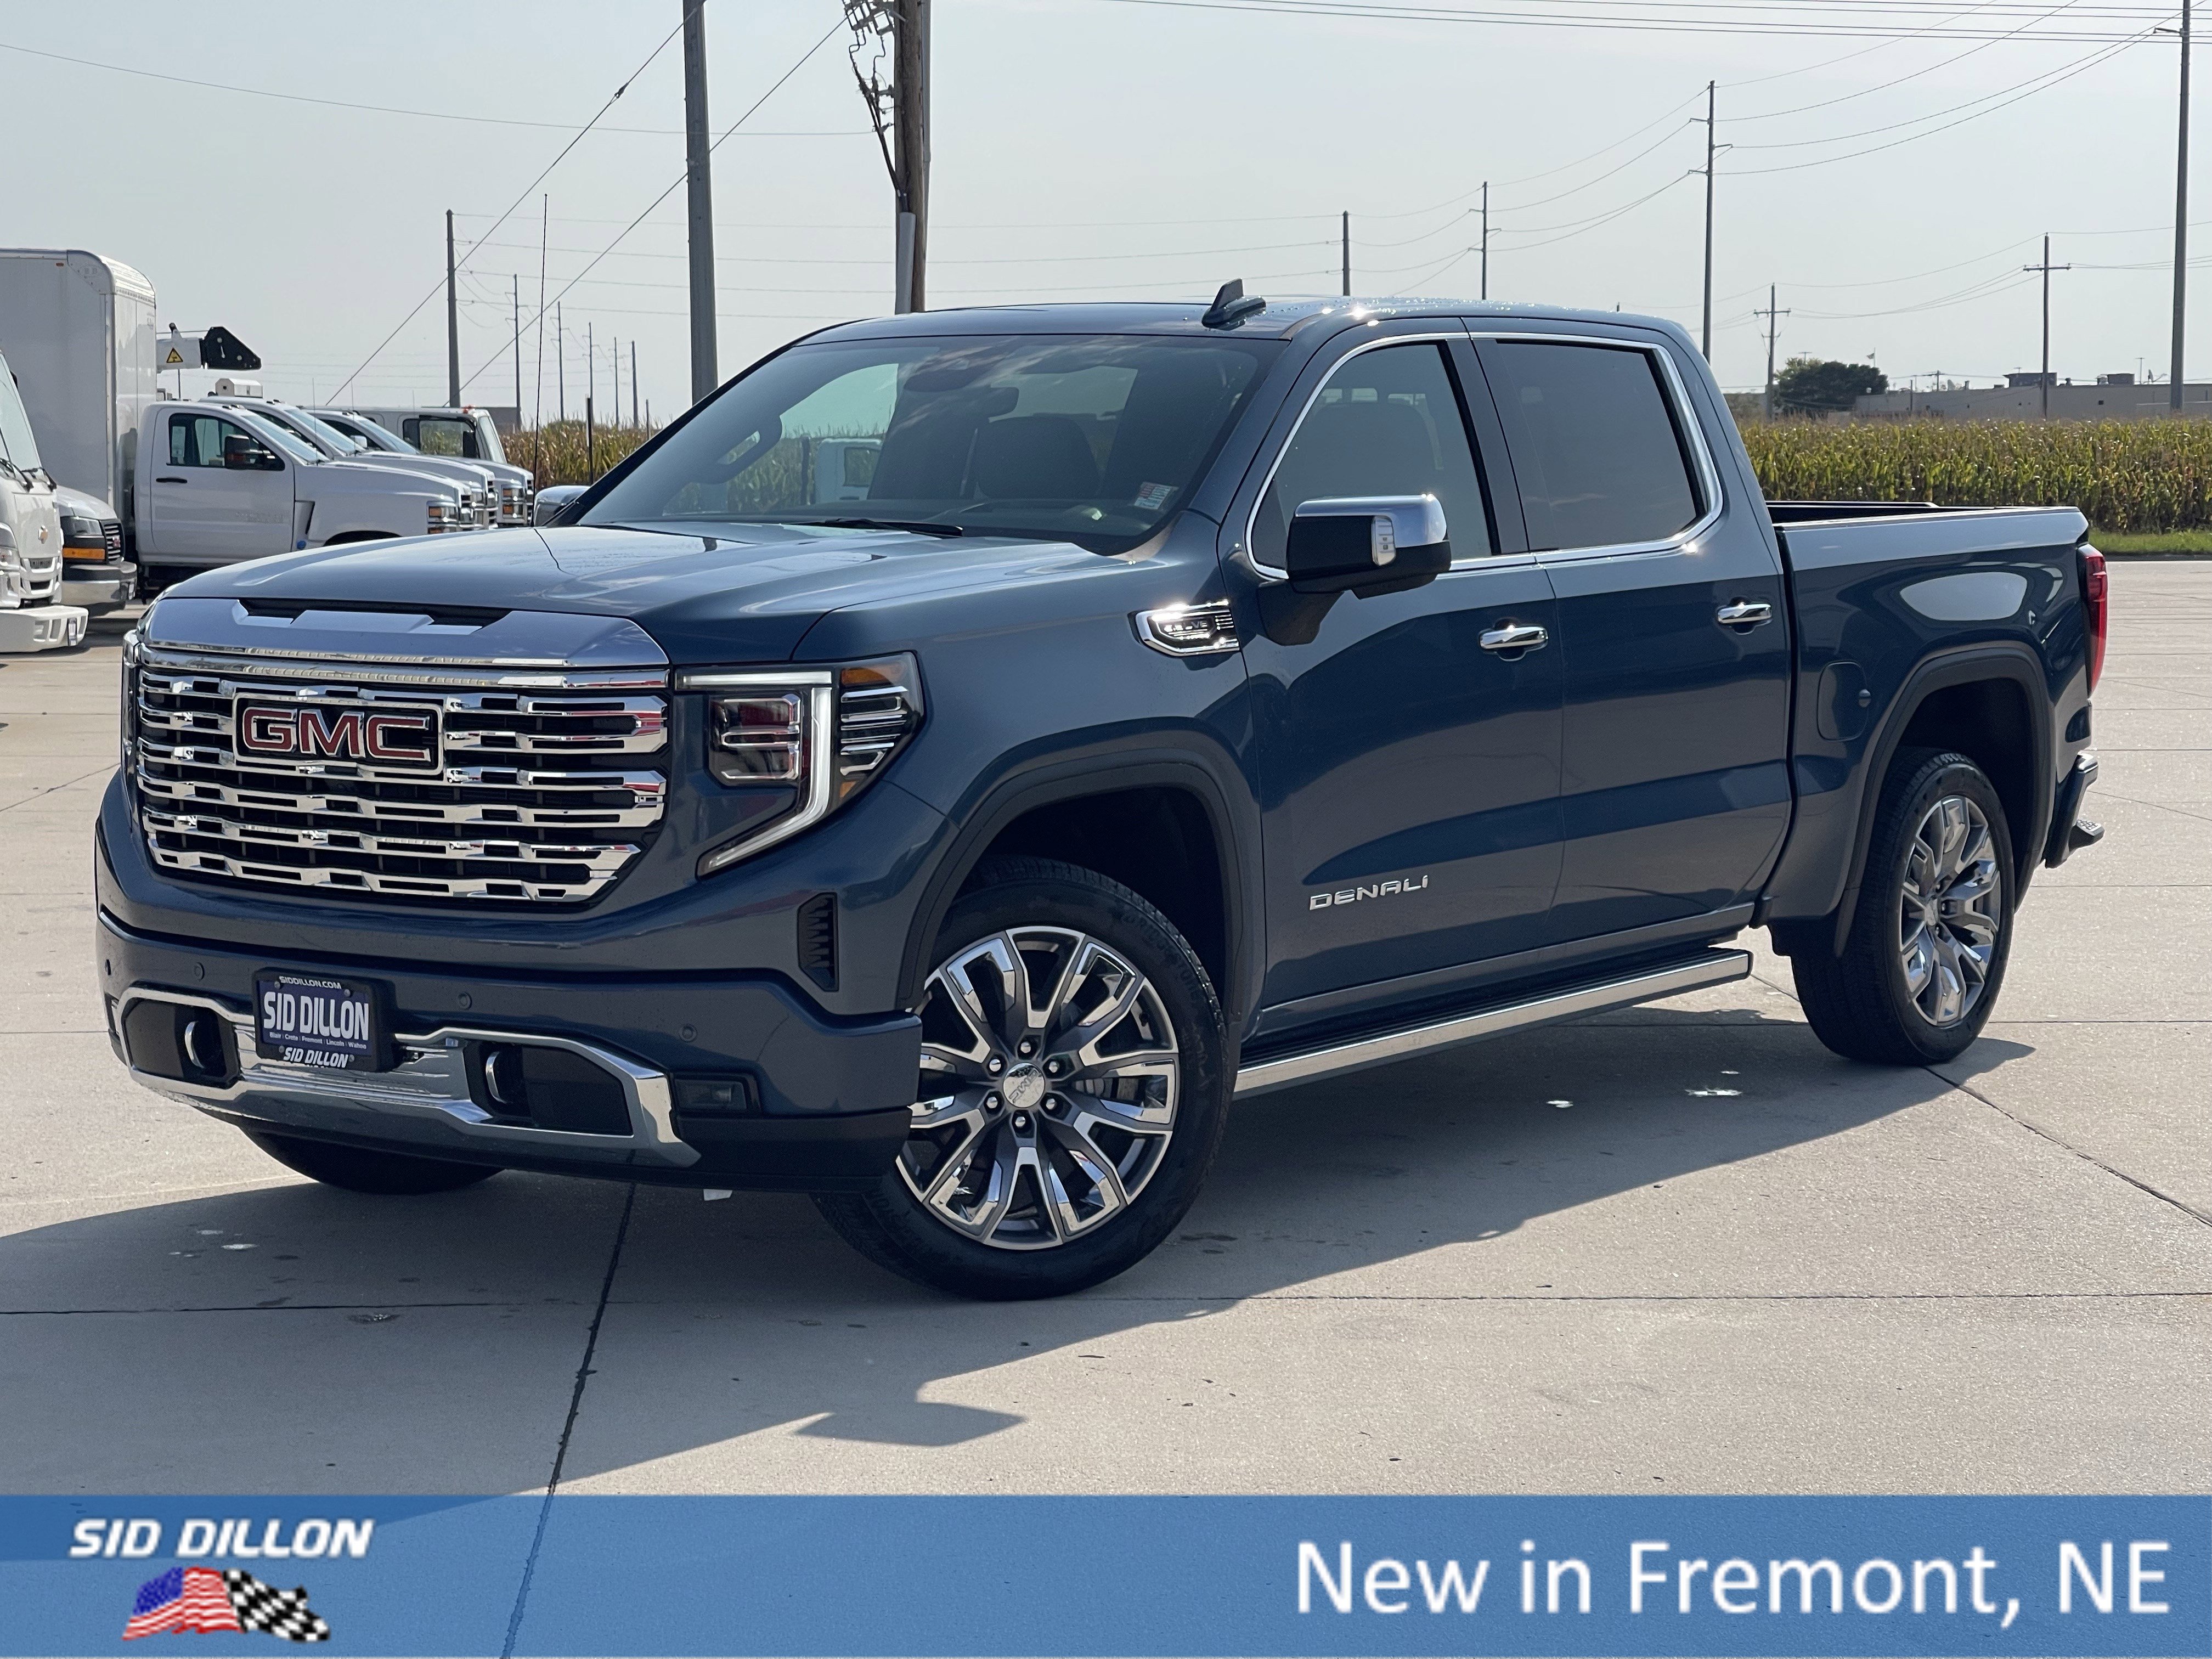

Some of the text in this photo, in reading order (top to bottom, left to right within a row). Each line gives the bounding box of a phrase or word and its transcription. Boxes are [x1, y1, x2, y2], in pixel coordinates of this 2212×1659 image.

[242, 706, 431, 762] GMC
[1309, 874, 1429, 911] DENALI
[279, 976, 342, 990] SIDDILLON.COM
[263, 991, 369, 1041] SID DILLON
[283, 1047, 349, 1068] SID DILLON
[326, 1039, 345, 1047] Lincoln
[1008, 1069, 1041, 1103] GMC
